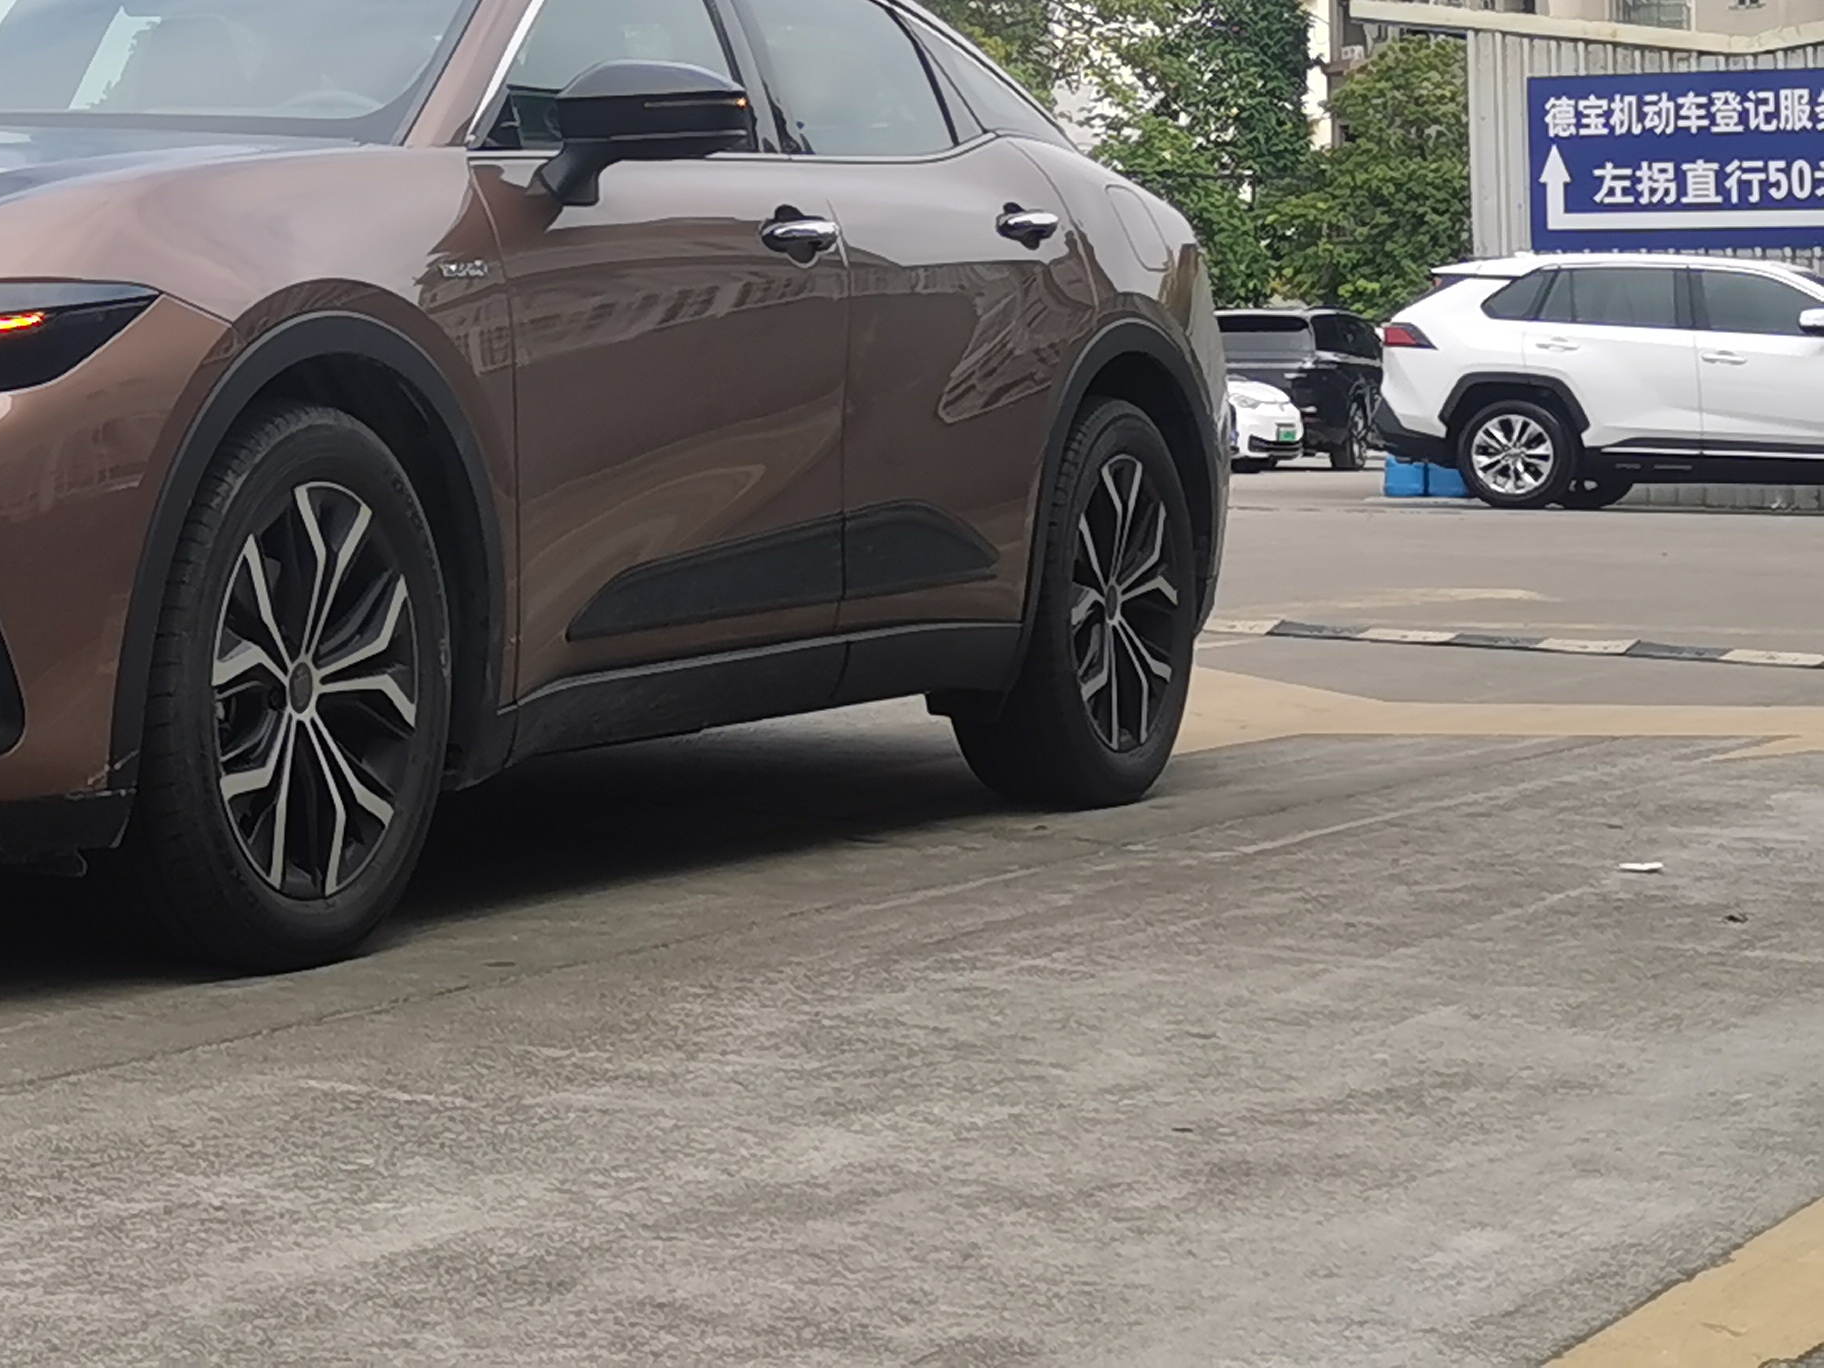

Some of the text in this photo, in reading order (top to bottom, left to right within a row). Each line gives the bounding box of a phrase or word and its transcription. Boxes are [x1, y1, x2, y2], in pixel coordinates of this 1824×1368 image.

[1544, 88, 1824, 137] 德宝机动车登记服
[1592, 158, 1824, 205] 左拐直行50
